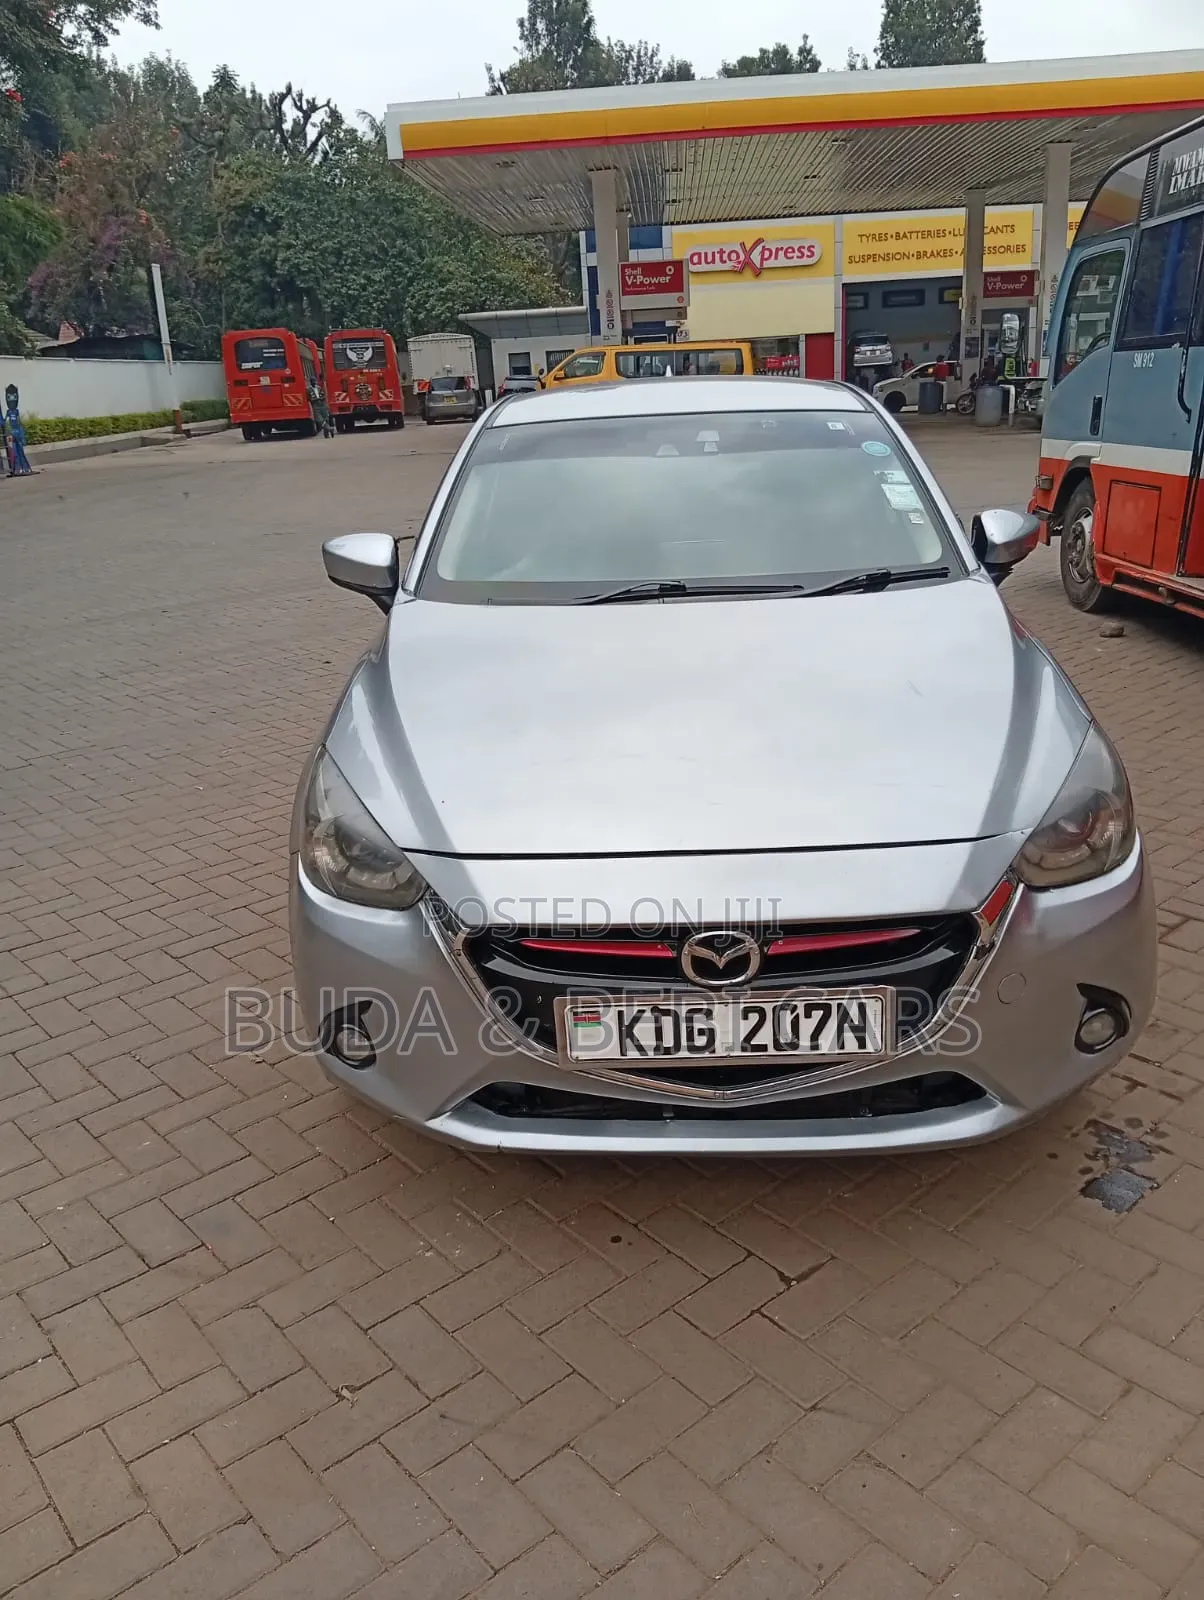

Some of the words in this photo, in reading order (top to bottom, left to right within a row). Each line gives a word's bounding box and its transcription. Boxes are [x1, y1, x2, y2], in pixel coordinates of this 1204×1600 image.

[858, 232, 889, 244] TYRES
[895, 228, 947, 241] BATTERIES
[952, 224, 1015, 237] LUCANTS
[689, 237, 816, 277] autoXpress
[848, 251, 911, 264] SUSPENSION
[915, 248, 954, 260] BRAKES
[959, 244, 1026, 257] AESSORIES
[624, 267, 642, 276] Shell
[625, 275, 672, 286] V-Power
[987, 282, 1025, 290] V-Power
[1143, 351, 1155, 368] 912
[616, 1004, 718, 1057] KDG
[740, 1001, 868, 1053] 207N
